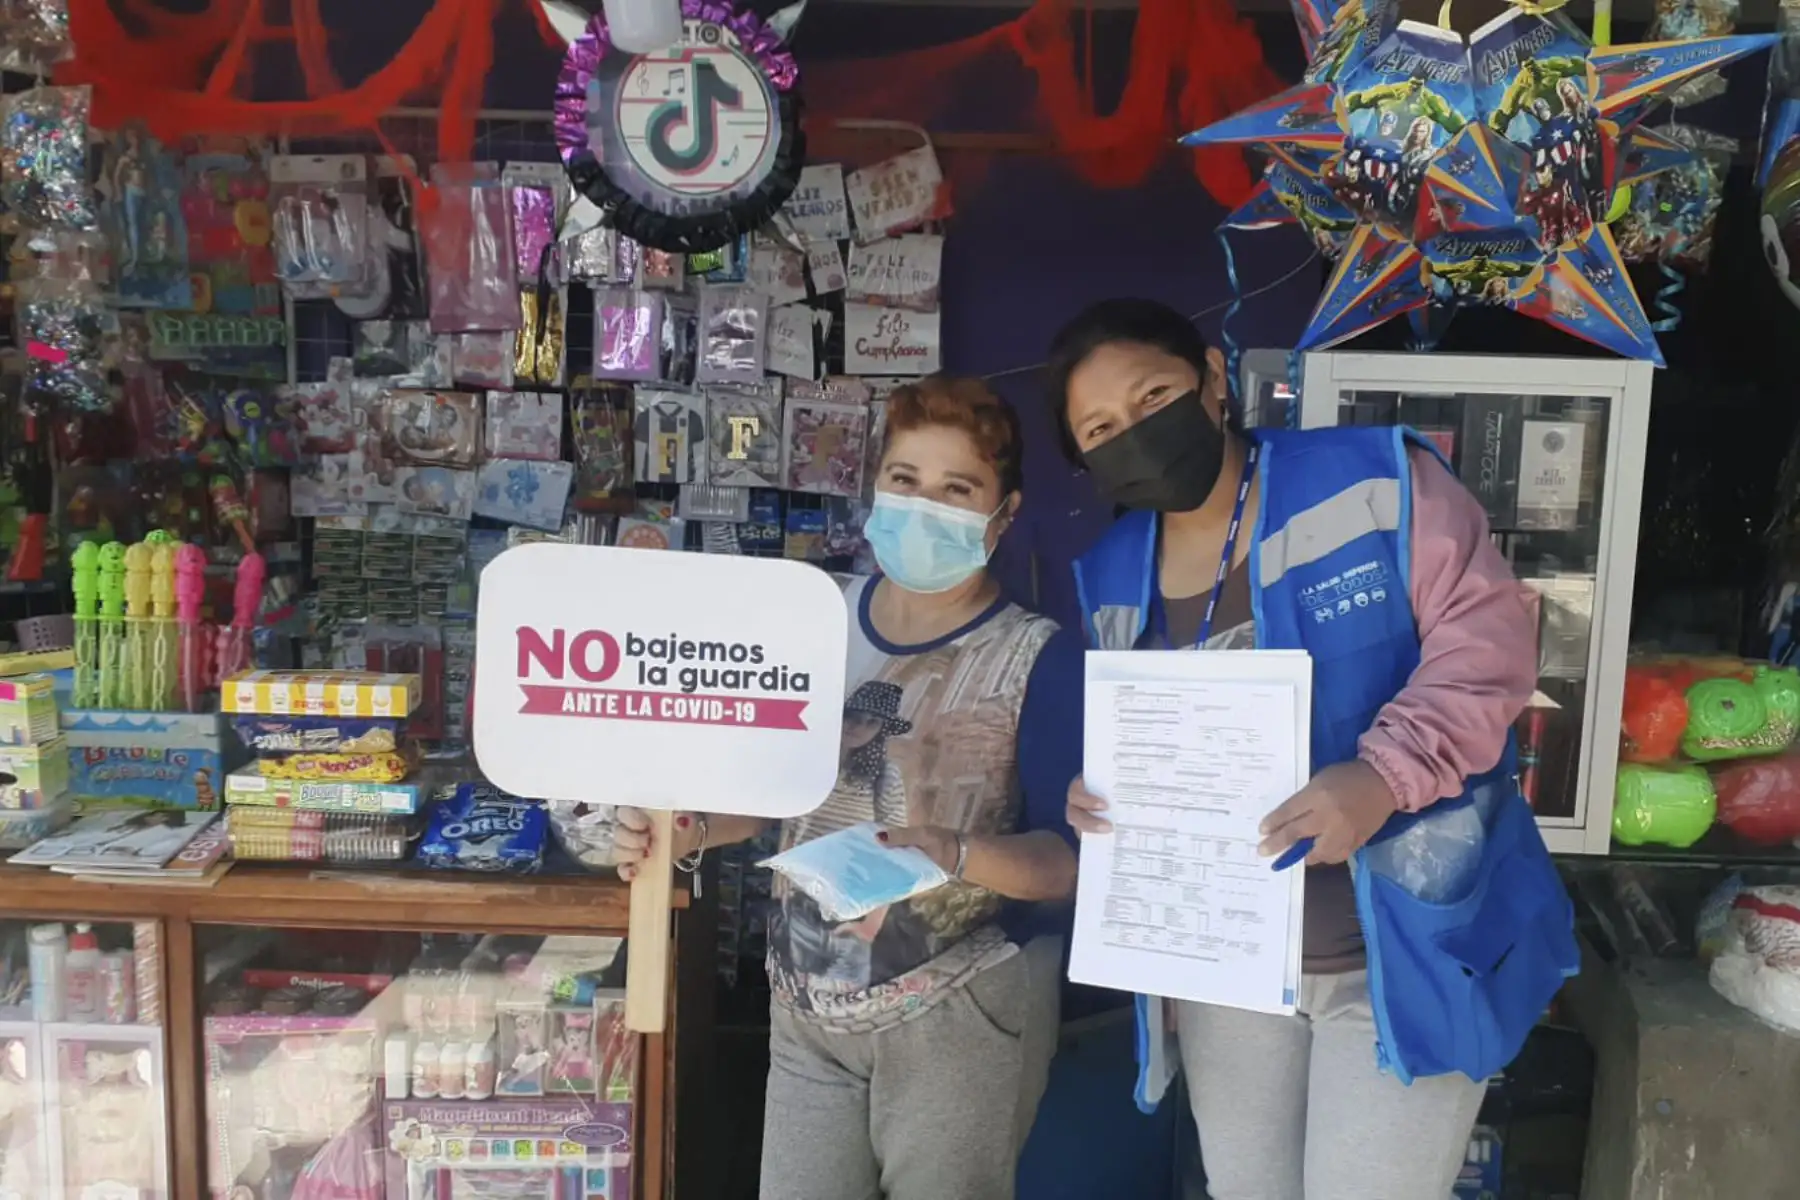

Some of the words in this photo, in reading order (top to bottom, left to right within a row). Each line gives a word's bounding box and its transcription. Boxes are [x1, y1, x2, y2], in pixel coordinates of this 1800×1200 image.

[728, 416, 759, 460] F
[516, 626, 620, 682] NO
[625, 632, 764, 664] bajemos
[638, 661, 667, 685] la
[679, 665, 810, 693] guardia
[562, 692, 619, 714] ANTE
[625, 695, 652, 716] LA
[660, 697, 756, 722] COVID-19
[441, 817, 525, 839] OREO
